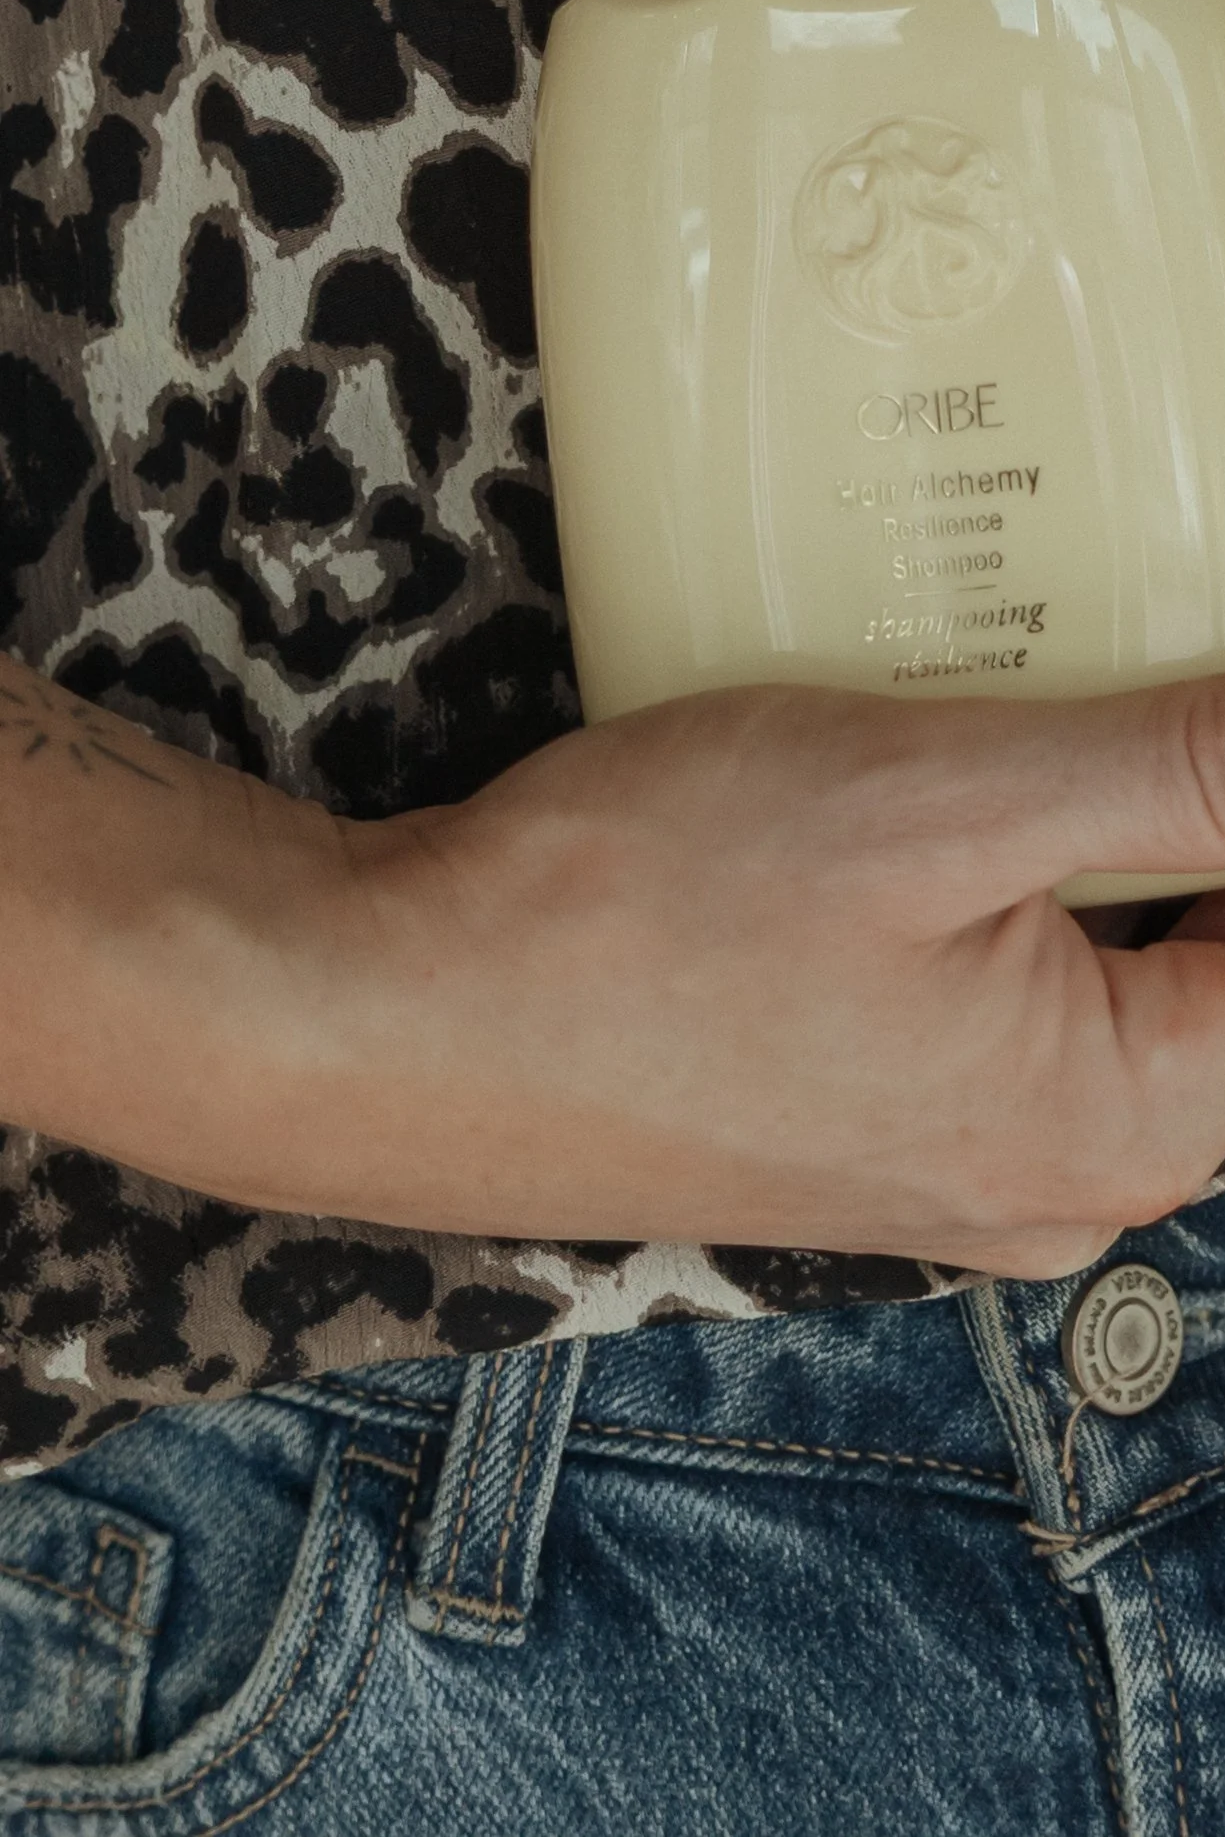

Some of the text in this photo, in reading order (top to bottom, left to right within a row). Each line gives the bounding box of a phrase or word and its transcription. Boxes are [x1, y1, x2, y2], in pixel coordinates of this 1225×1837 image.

[857, 382, 1005, 441] ORIBE
[911, 466, 1041, 504] Alchemy
[882, 512, 1004, 544] Resilience
[865, 598, 1048, 644] shampooing
